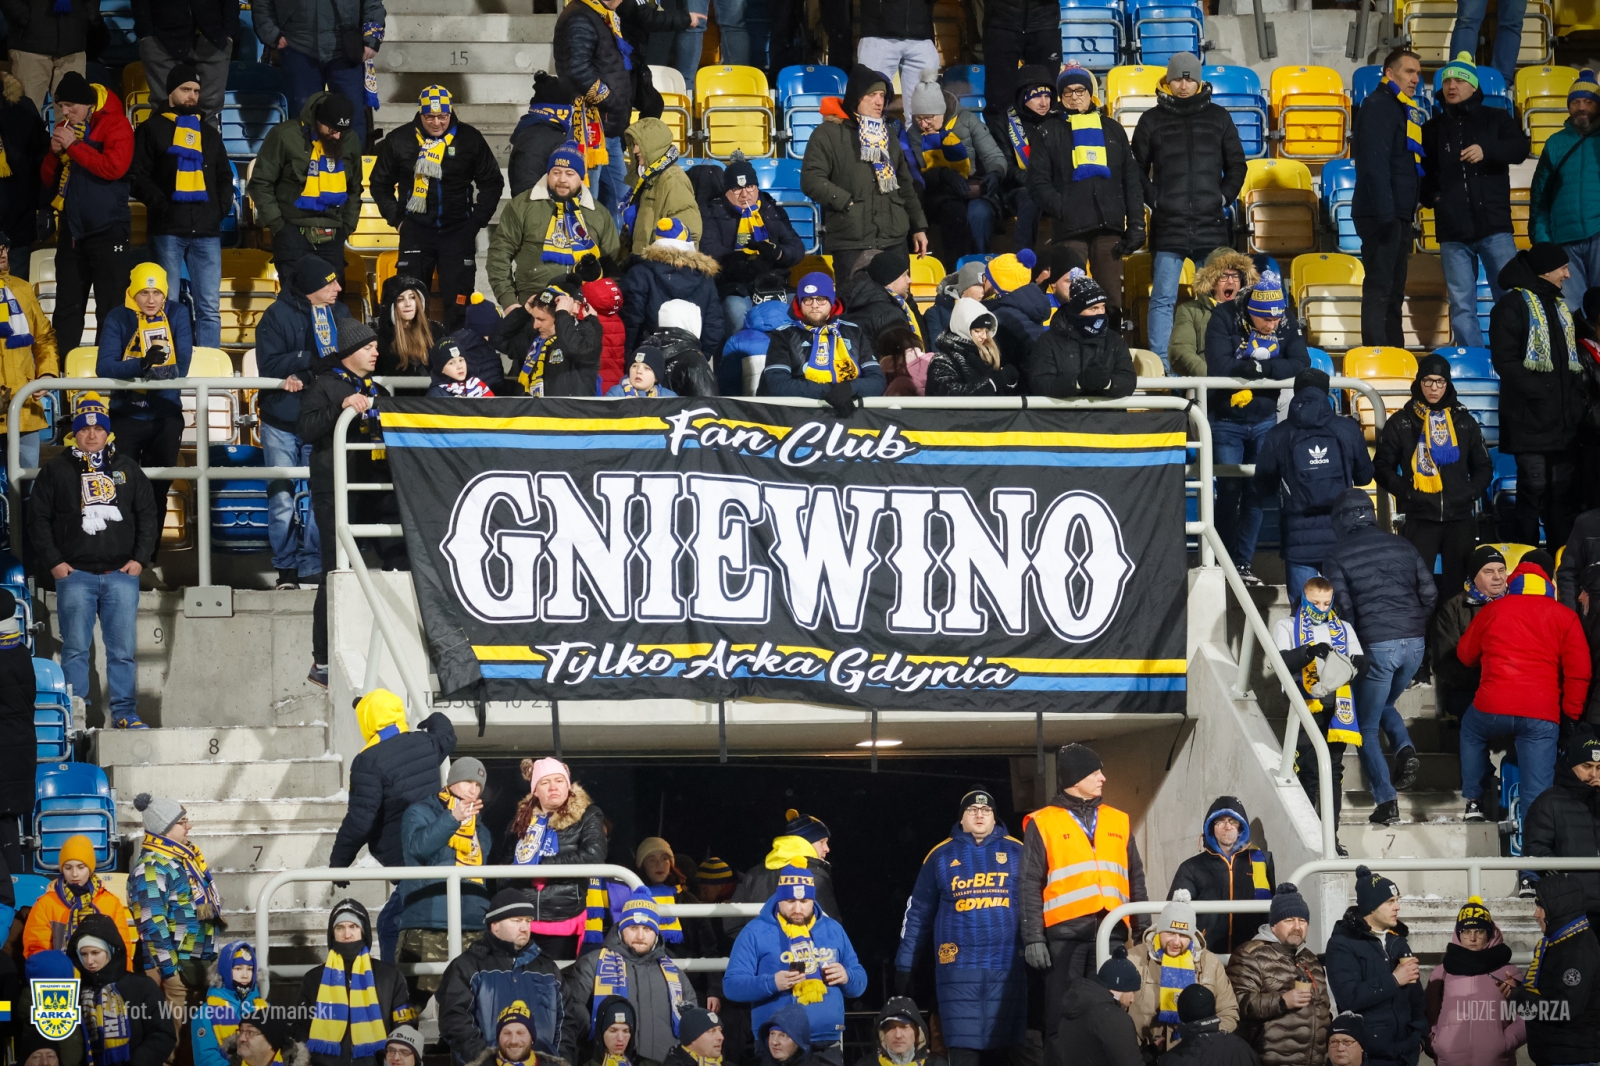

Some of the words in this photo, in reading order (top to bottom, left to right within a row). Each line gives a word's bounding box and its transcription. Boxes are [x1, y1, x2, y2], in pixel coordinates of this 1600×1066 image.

[450, 51, 469, 66] 15
[665, 408, 772, 455] Fan
[779, 421, 916, 466] Club
[439, 470, 1136, 643] GNIEWINO
[153, 628, 164, 644] 9
[535, 641, 672, 684] Tylko
[683, 639, 822, 680] Arka
[829, 647, 1015, 694] Gdynia
[209, 738, 220, 755] 8
[1386, 834, 1396, 850] 7
[252, 846, 263, 862] 7
[951, 872, 1009, 891] forBET
[955, 897, 1009, 912] GDYNIA
[1171, 921, 1188, 930] ARKA
